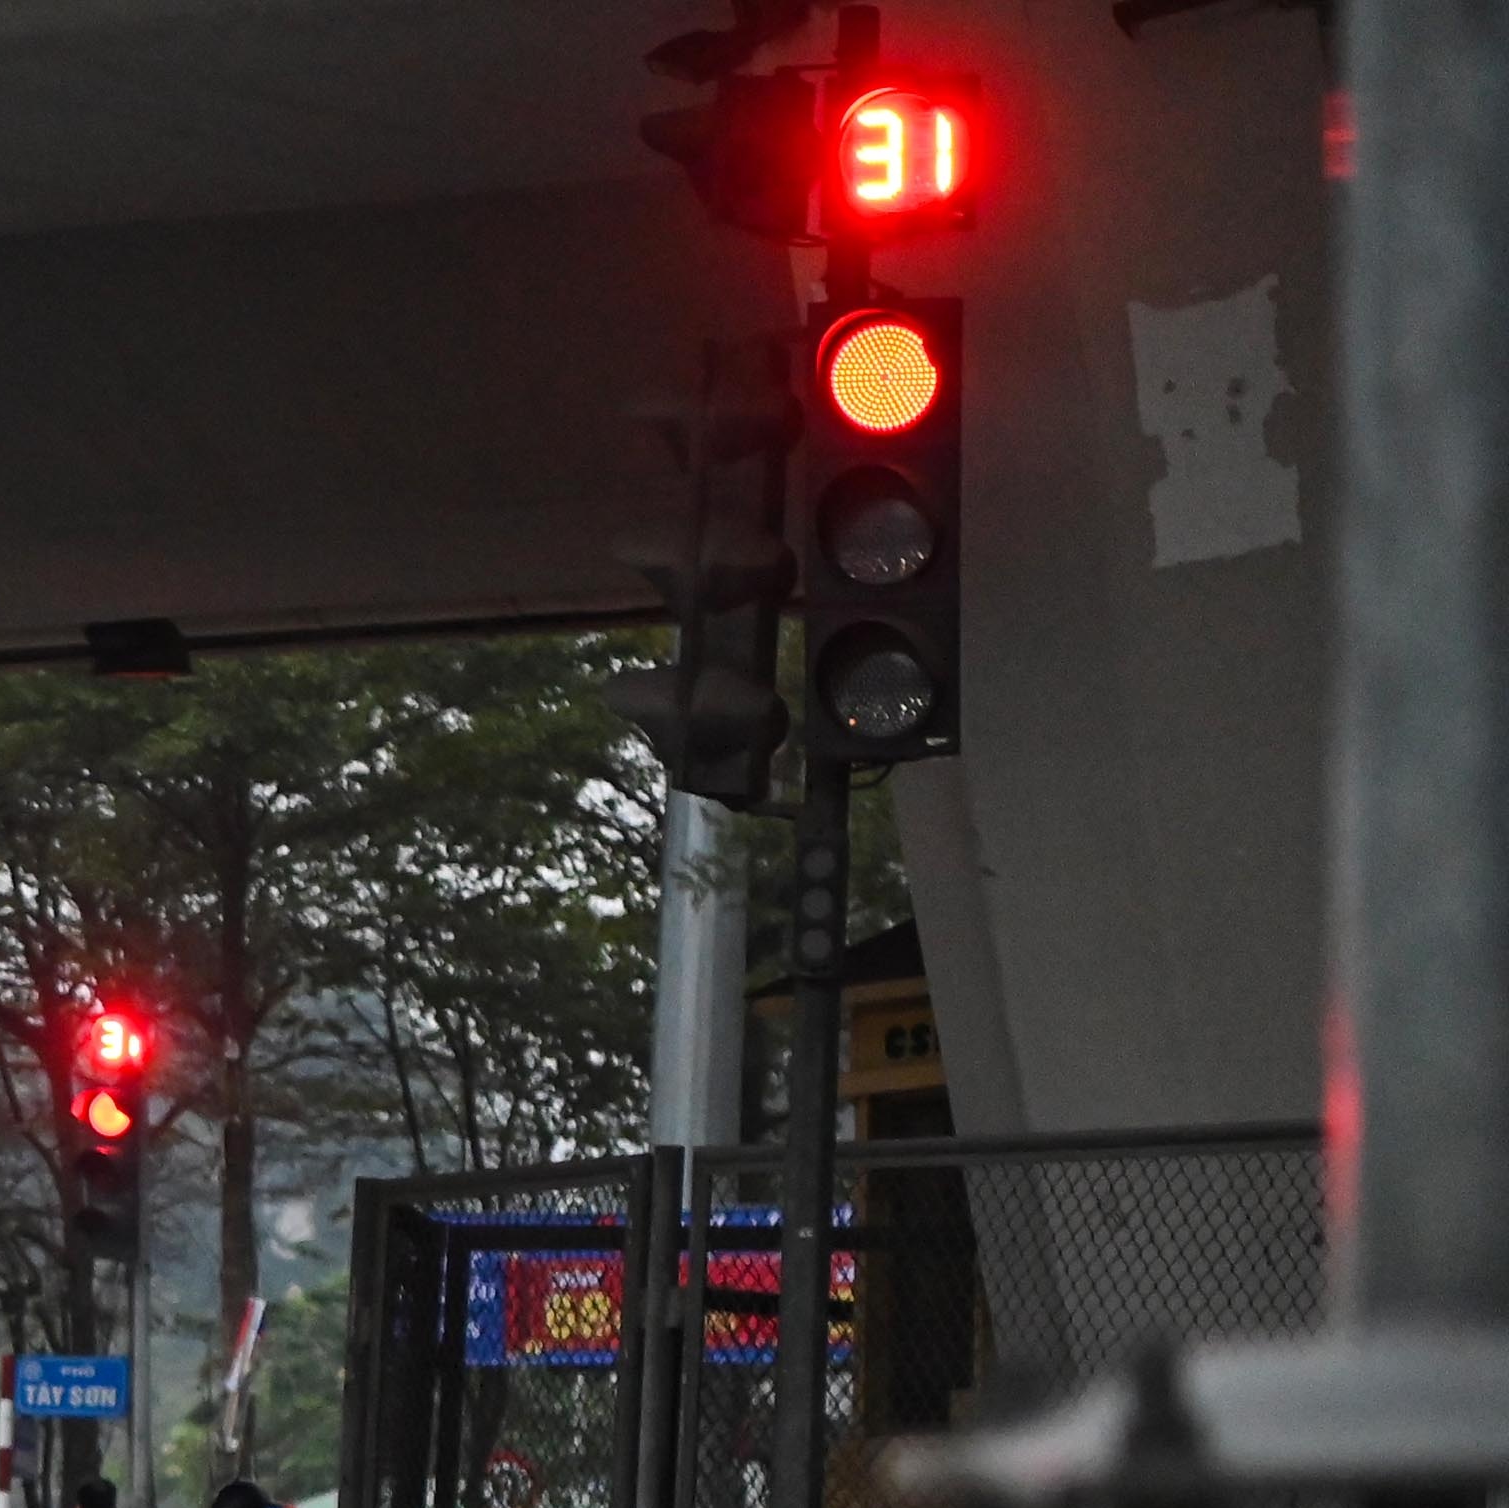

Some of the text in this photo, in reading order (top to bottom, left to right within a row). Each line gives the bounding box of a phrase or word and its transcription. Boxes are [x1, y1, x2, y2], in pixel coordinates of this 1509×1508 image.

[855, 108, 953, 201] 31
[26, 1381, 118, 1409] TÂY SƠN
